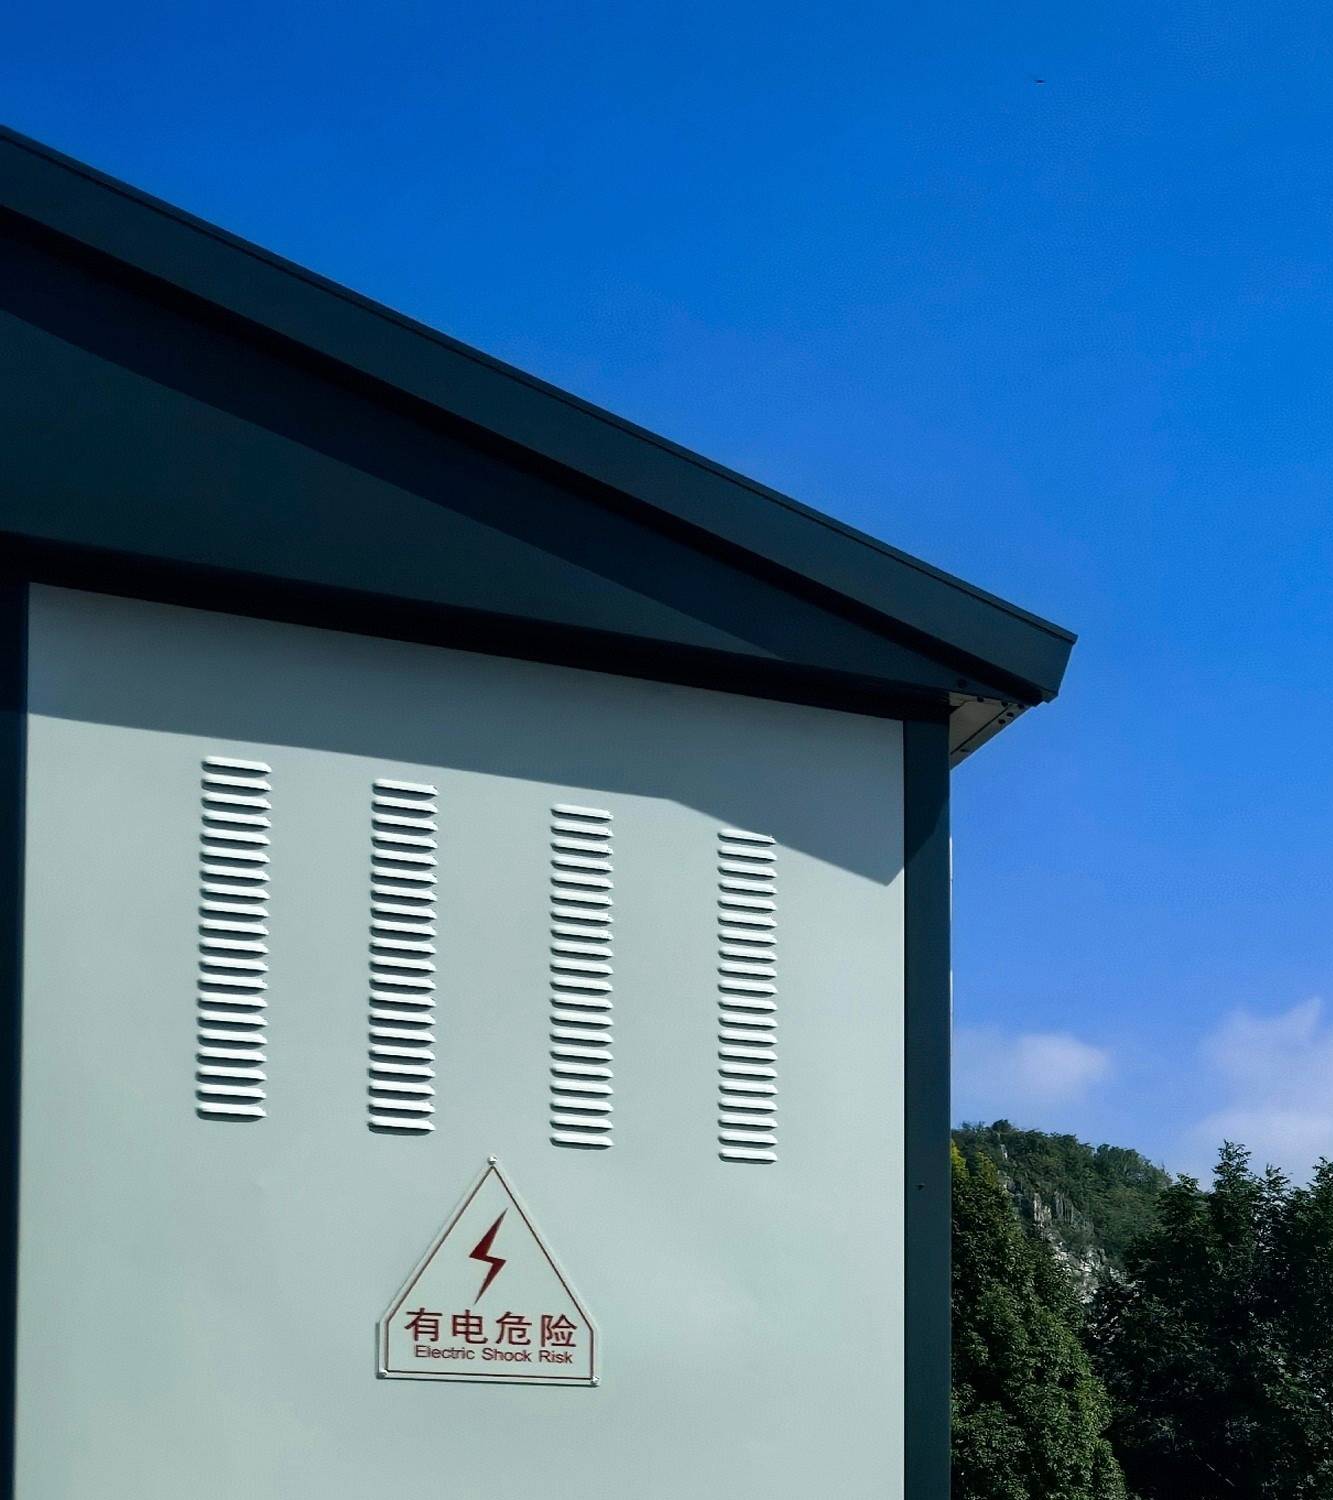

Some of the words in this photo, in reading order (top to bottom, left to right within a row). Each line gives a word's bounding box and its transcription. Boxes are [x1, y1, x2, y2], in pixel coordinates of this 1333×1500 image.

[404, 1307, 577, 1347] 有电危险
[415, 1344, 475, 1360] Electric
[481, 1347, 532, 1362] Shock
[538, 1350, 573, 1364] Risk
